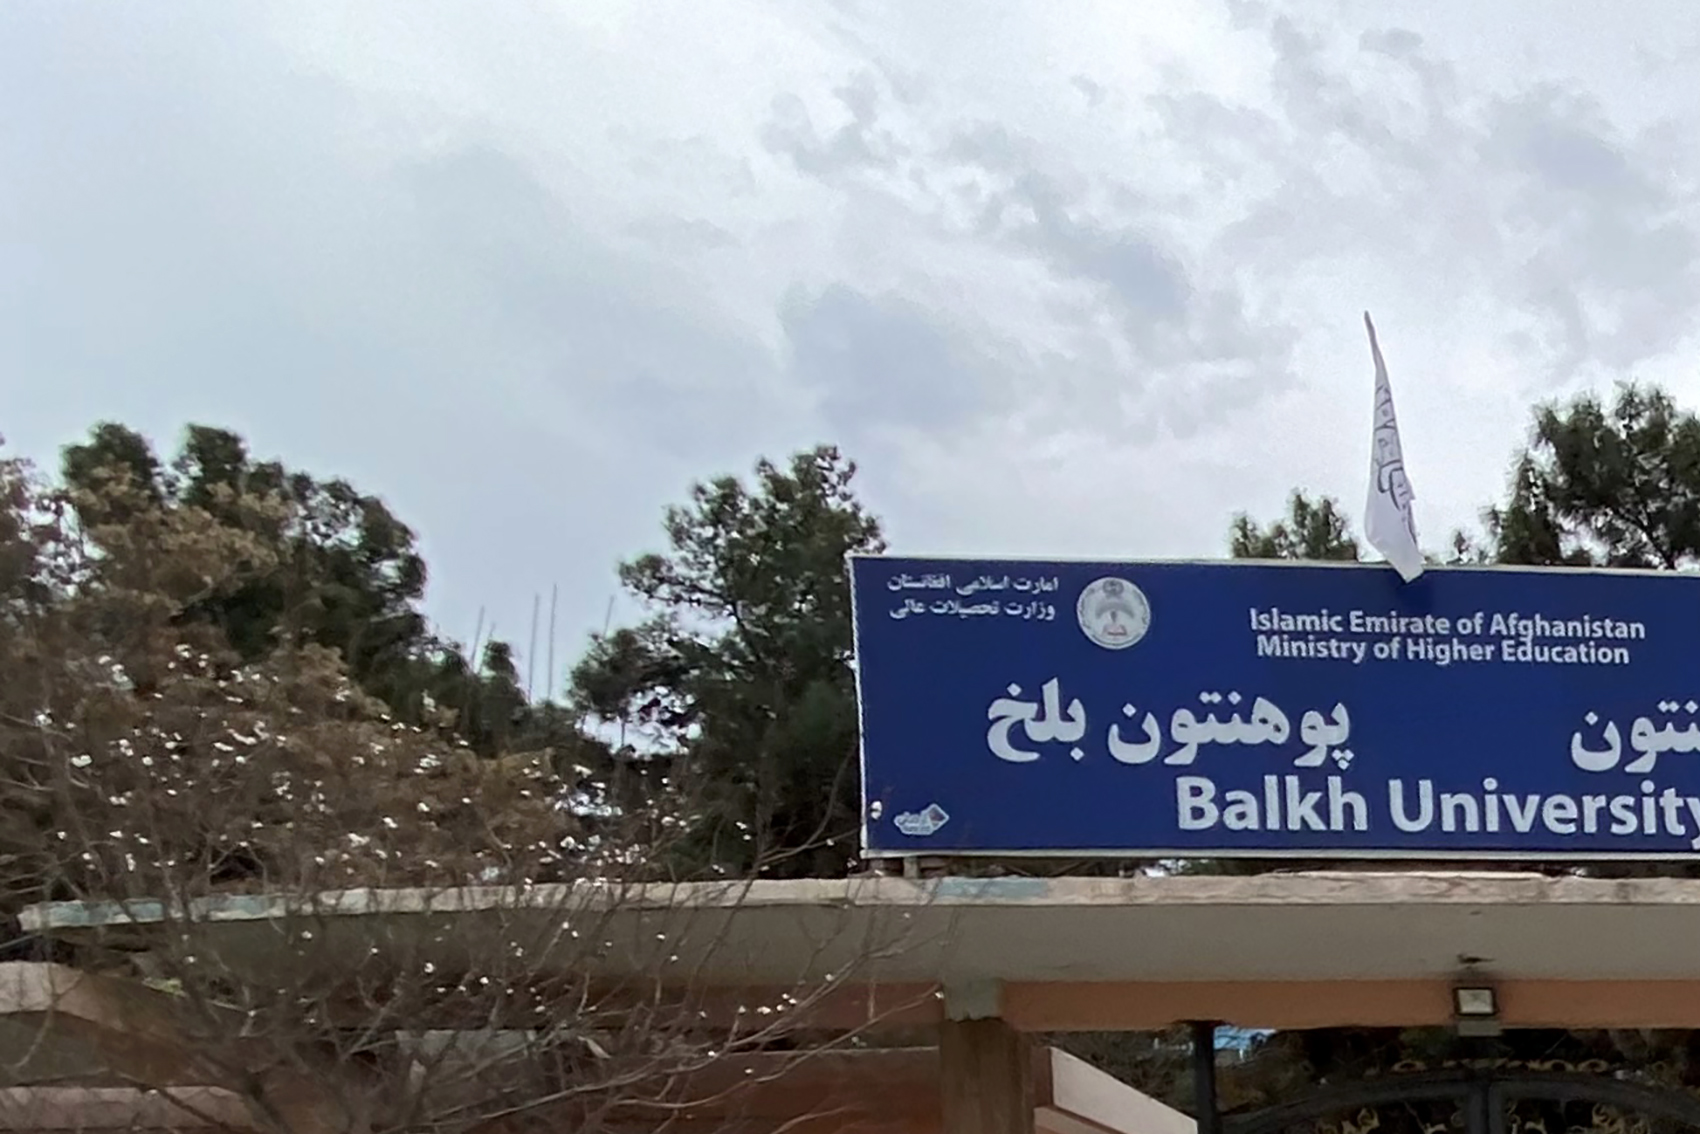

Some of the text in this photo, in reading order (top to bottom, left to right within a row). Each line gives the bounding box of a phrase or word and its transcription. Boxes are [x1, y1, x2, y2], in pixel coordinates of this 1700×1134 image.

[1013, 576, 1059, 595] امارت
[1004, 600, 1056, 621] وزارت
[1249, 607, 1646, 643] Islamic Emirate of Afghanistan
[1257, 634, 1630, 666] Ministry of Higher Education
[986, 676, 1355, 771] پوهنتون بلخ
[1175, 774, 1369, 832] Balkh
